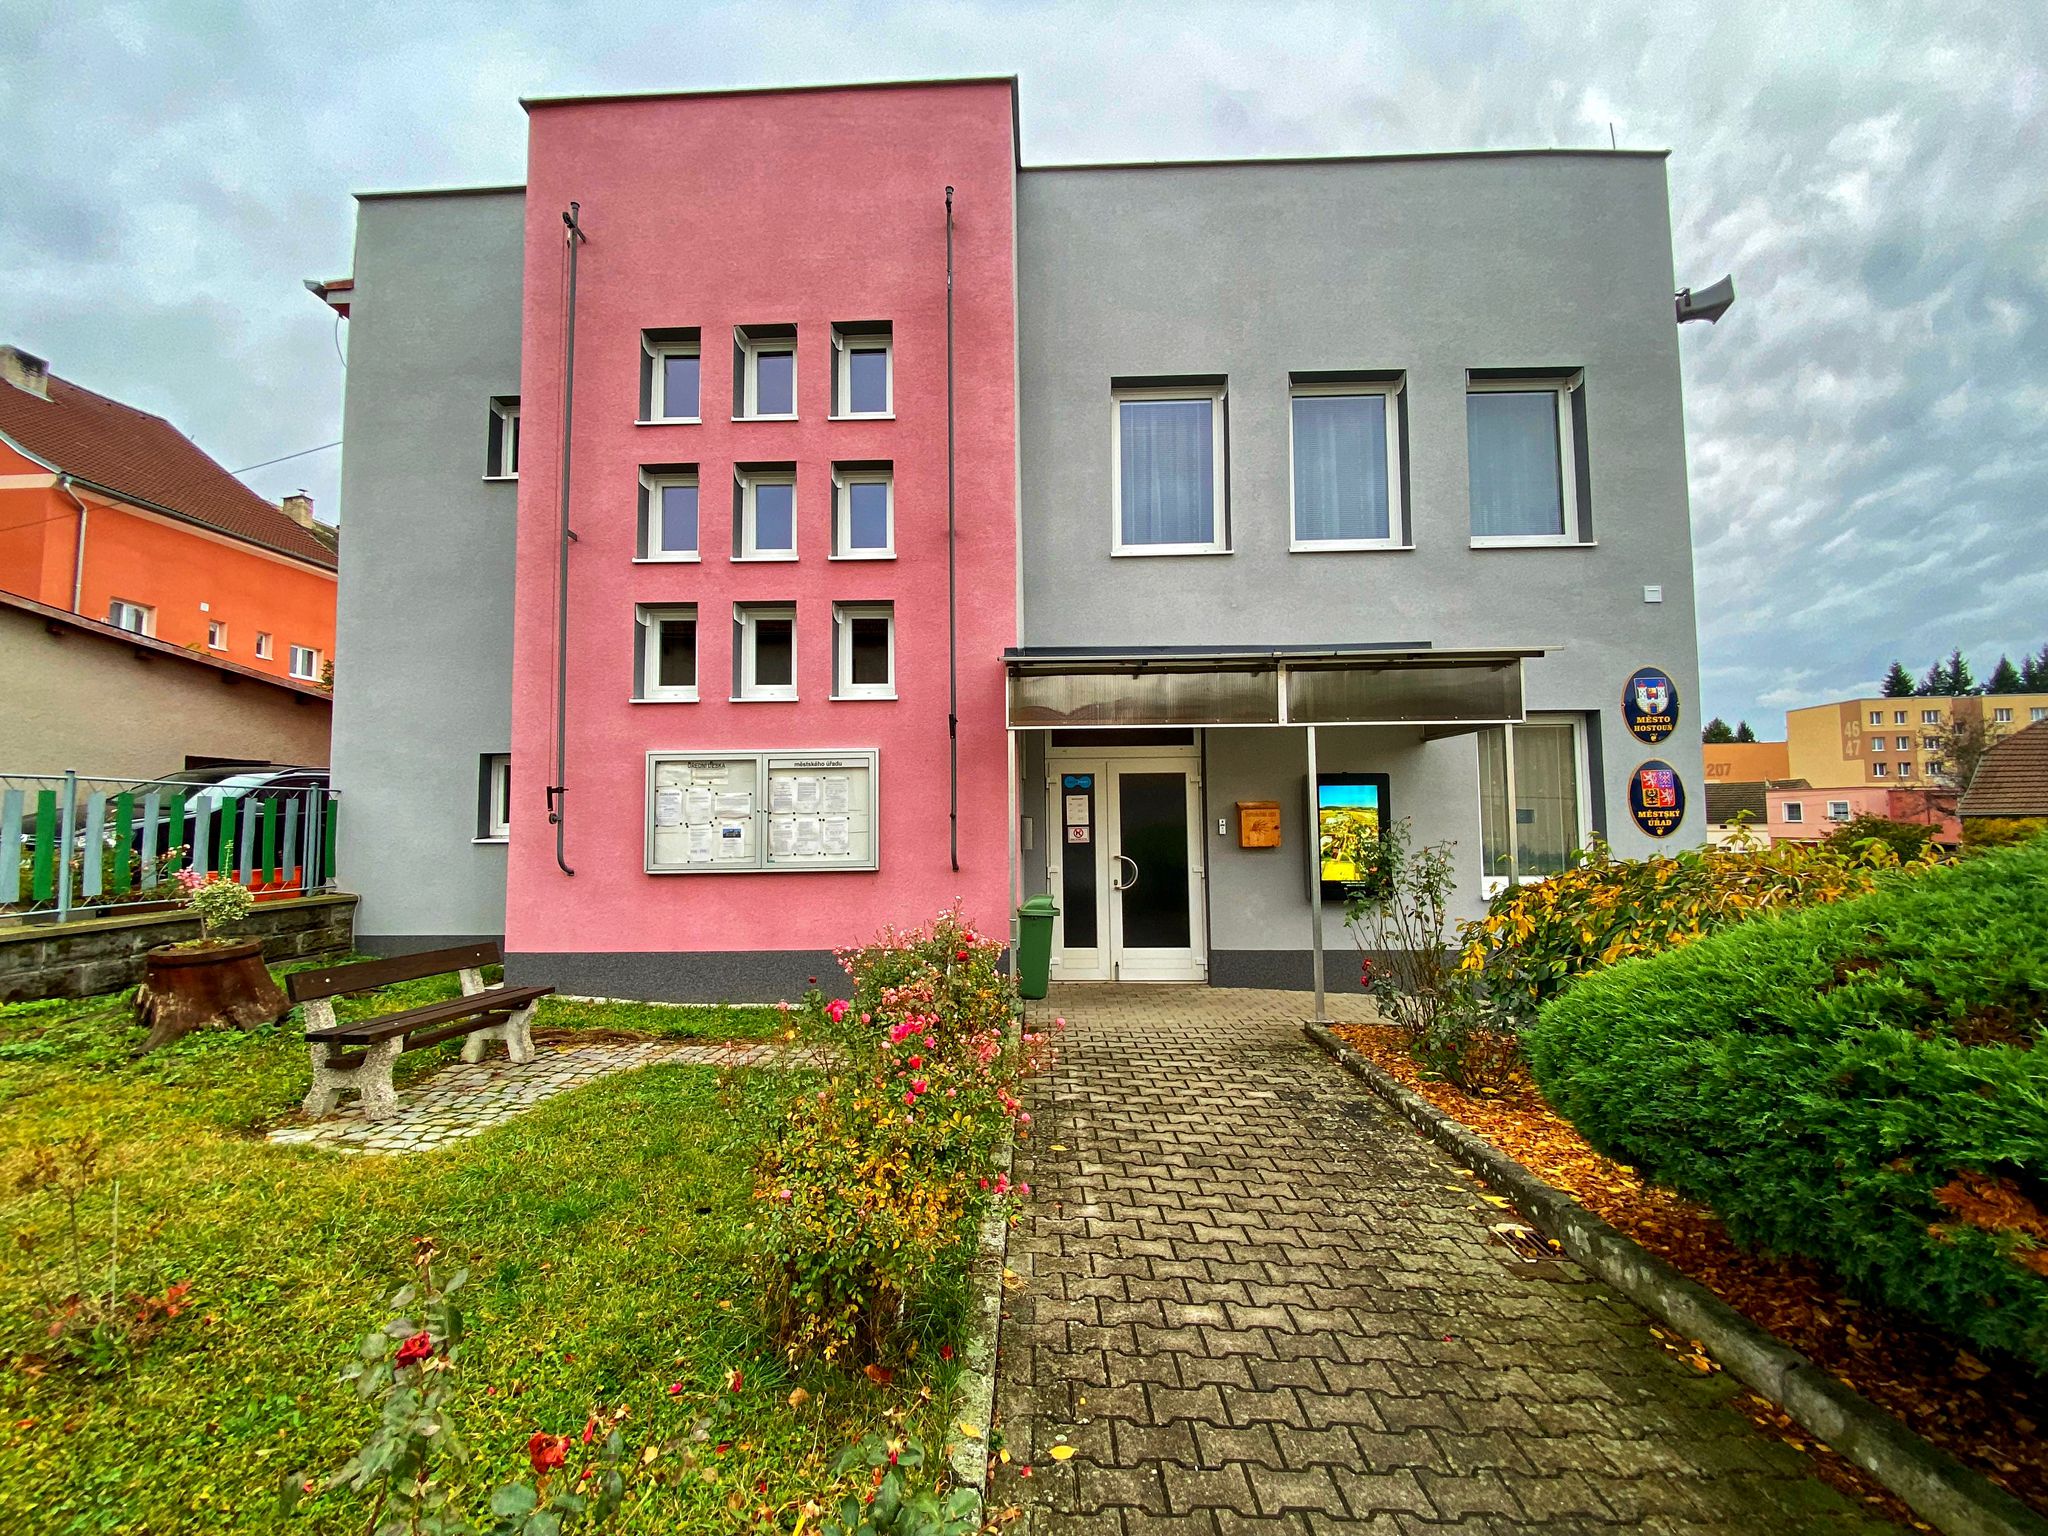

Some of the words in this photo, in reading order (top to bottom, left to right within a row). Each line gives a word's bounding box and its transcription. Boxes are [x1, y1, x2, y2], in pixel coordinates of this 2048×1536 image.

[1636, 715, 1671, 723] MĚSTO
[1633, 723, 1673, 732] HOSTOUŇ
[1845, 720, 1860, 737] 46
[1845, 739, 1861, 756] 47
[1706, 763, 1731, 777] 207
[1638, 809, 1680, 818] MĚSTSKÝ
[1648, 818, 1672, 826] ÚŘAD
